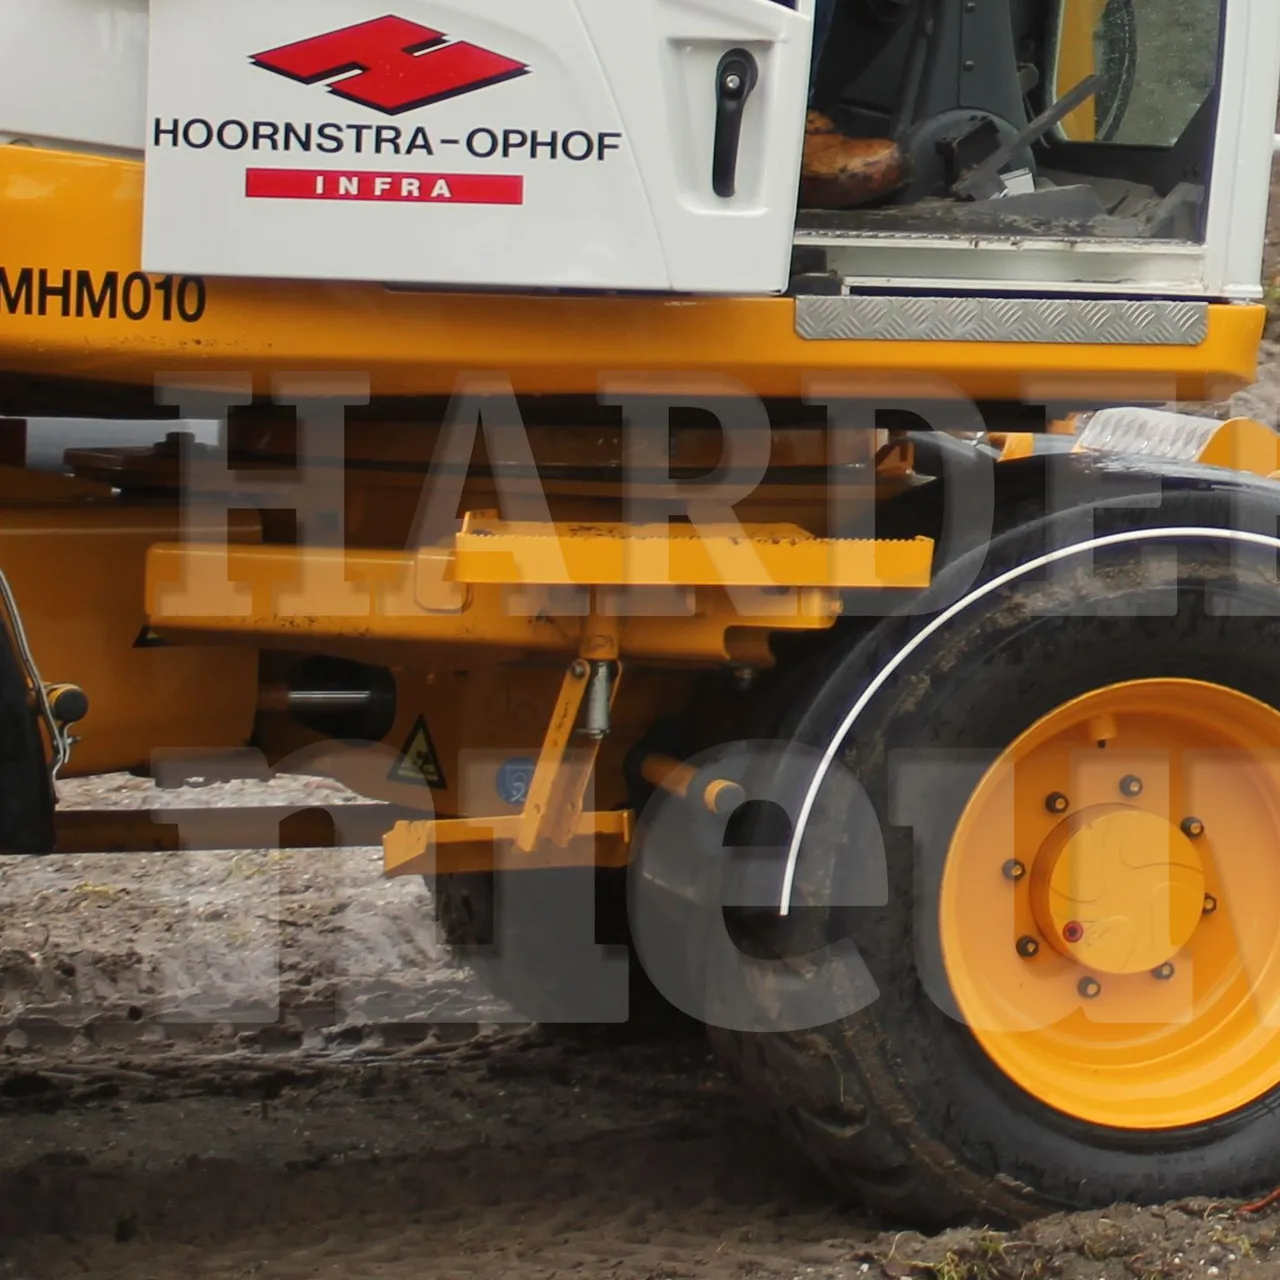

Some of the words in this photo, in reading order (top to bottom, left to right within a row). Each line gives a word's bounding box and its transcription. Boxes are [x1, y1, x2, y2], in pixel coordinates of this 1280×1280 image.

[153, 116, 623, 162] HOORNSTRA-OPHOF
[314, 174, 453, 198] INFRA
[0, 266, 207, 323] MHM010
